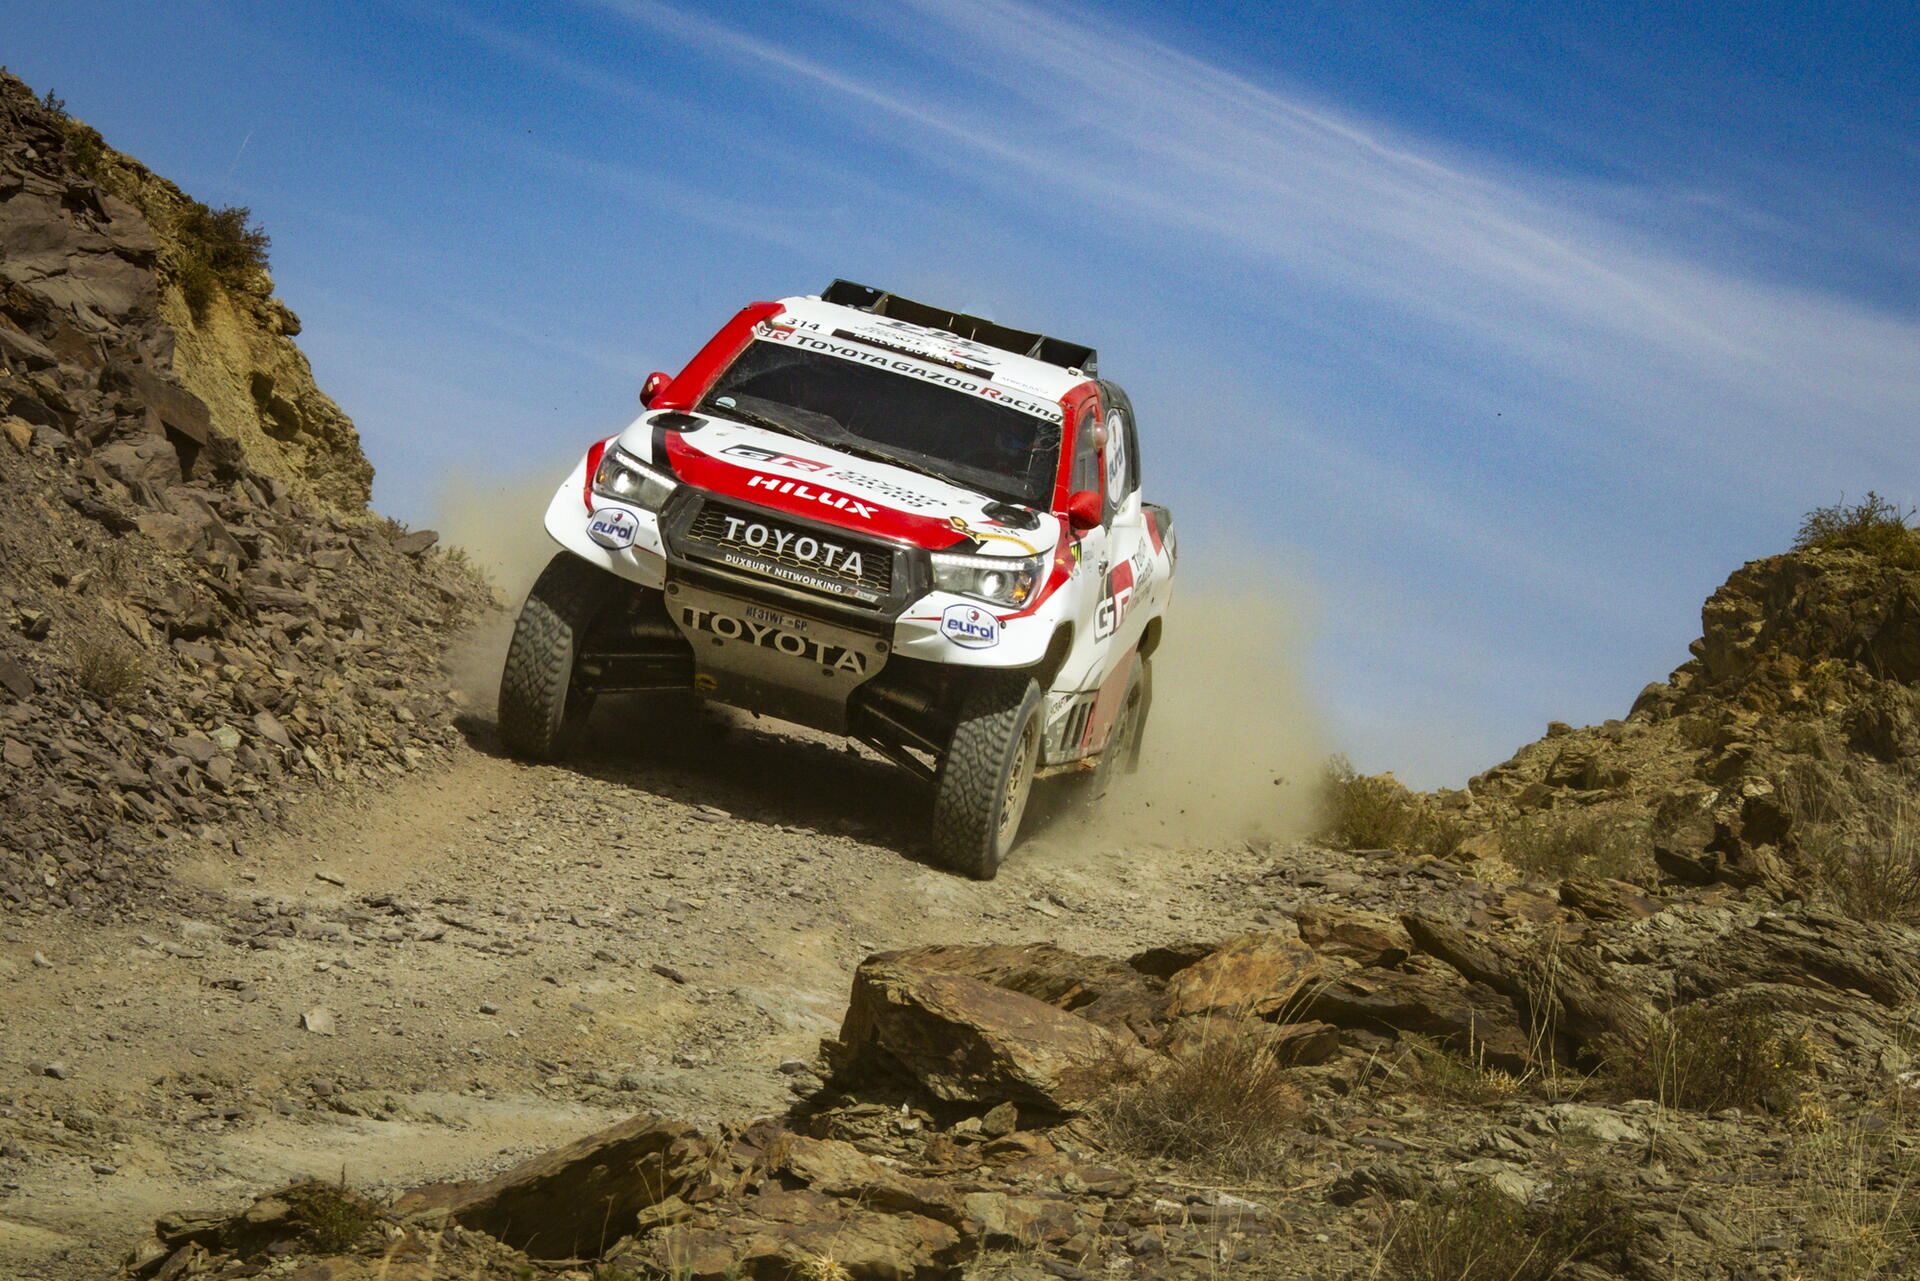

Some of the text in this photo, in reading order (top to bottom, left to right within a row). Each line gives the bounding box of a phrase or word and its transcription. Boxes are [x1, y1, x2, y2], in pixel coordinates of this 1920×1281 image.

[785, 317, 820, 331] 314
[796, 335, 887, 367] TOYOTA
[890, 361, 978, 392] GAZOO
[979, 387, 1064, 423] Racing
[721, 446, 828, 472] GR
[747, 475, 879, 519] HILUX
[592, 521, 633, 540] eurol
[724, 515, 863, 576] TOYOTA
[725, 554, 843, 593] DUXBURY NETWORKING
[683, 606, 866, 676] TOYOTA
[947, 618, 994, 639] eurol
